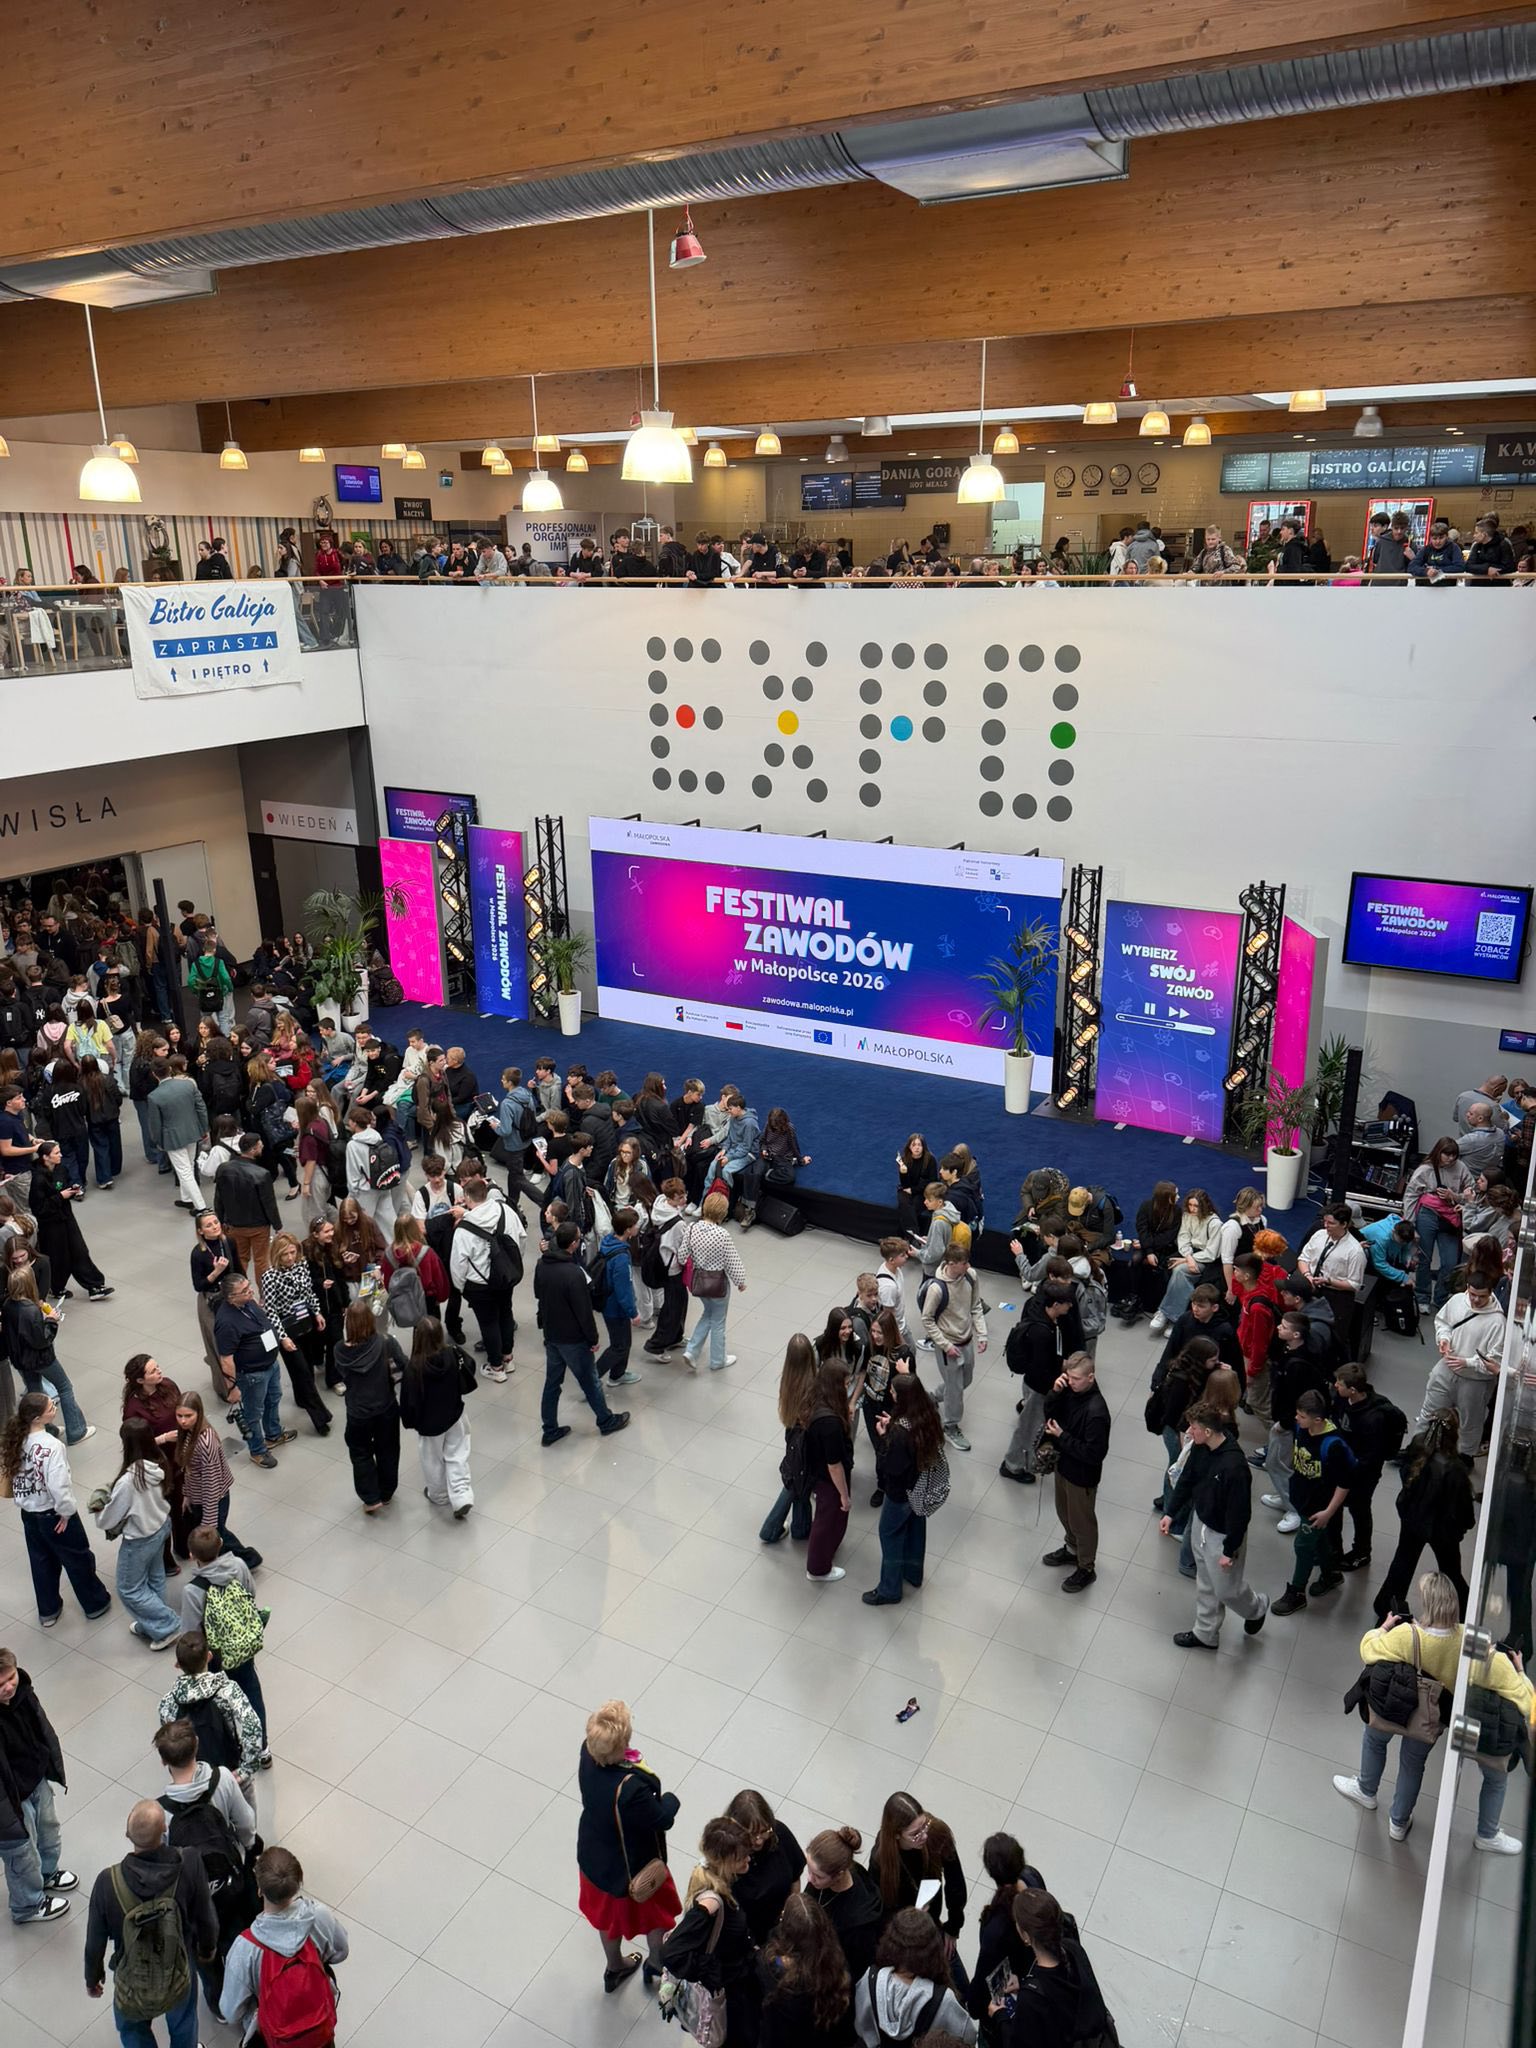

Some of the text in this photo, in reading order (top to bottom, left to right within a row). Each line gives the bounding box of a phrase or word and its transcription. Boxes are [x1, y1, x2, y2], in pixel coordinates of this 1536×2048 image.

[1498, 442, 1536, 457] KAW
[1311, 462, 1362, 475] BISTRO
[1367, 460, 1427, 474] GALICJA
[1522, 458, 1536, 466] CO
[882, 468, 921, 480] DANIA
[525, 522, 597, 534] PROFESJONALNA
[549, 542, 568, 551] IMP
[149, 593, 277, 627] Bistro Galicja
[159, 636, 274, 656] ZAPRASZA
[202, 663, 252, 680] PIĘTRO
[0, 796, 117, 838] WISŁA
[278, 813, 354, 833] WIEDEŃ A
[706, 885, 851, 930] FESTIWAL
[1367, 902, 1426, 918] FESTIWAL
[1380, 915, 1449, 931] ZAWODÓW
[495, 864, 512, 1001] FESTIWAL ZAWODÓW
[1419, 930, 1437, 938] 2026
[743, 922, 914, 972] ZAWODÓW
[1121, 943, 1178, 961] WYBIERZ
[1475, 945, 1511, 955] ZOBACZ
[734, 957, 885, 991] w Małopolsce 2026
[1149, 963, 1196, 982] SWÓJ
[1166, 983, 1214, 1001] ZAWÓD
[873, 1043, 954, 1066] MAŁOPOLSKA
